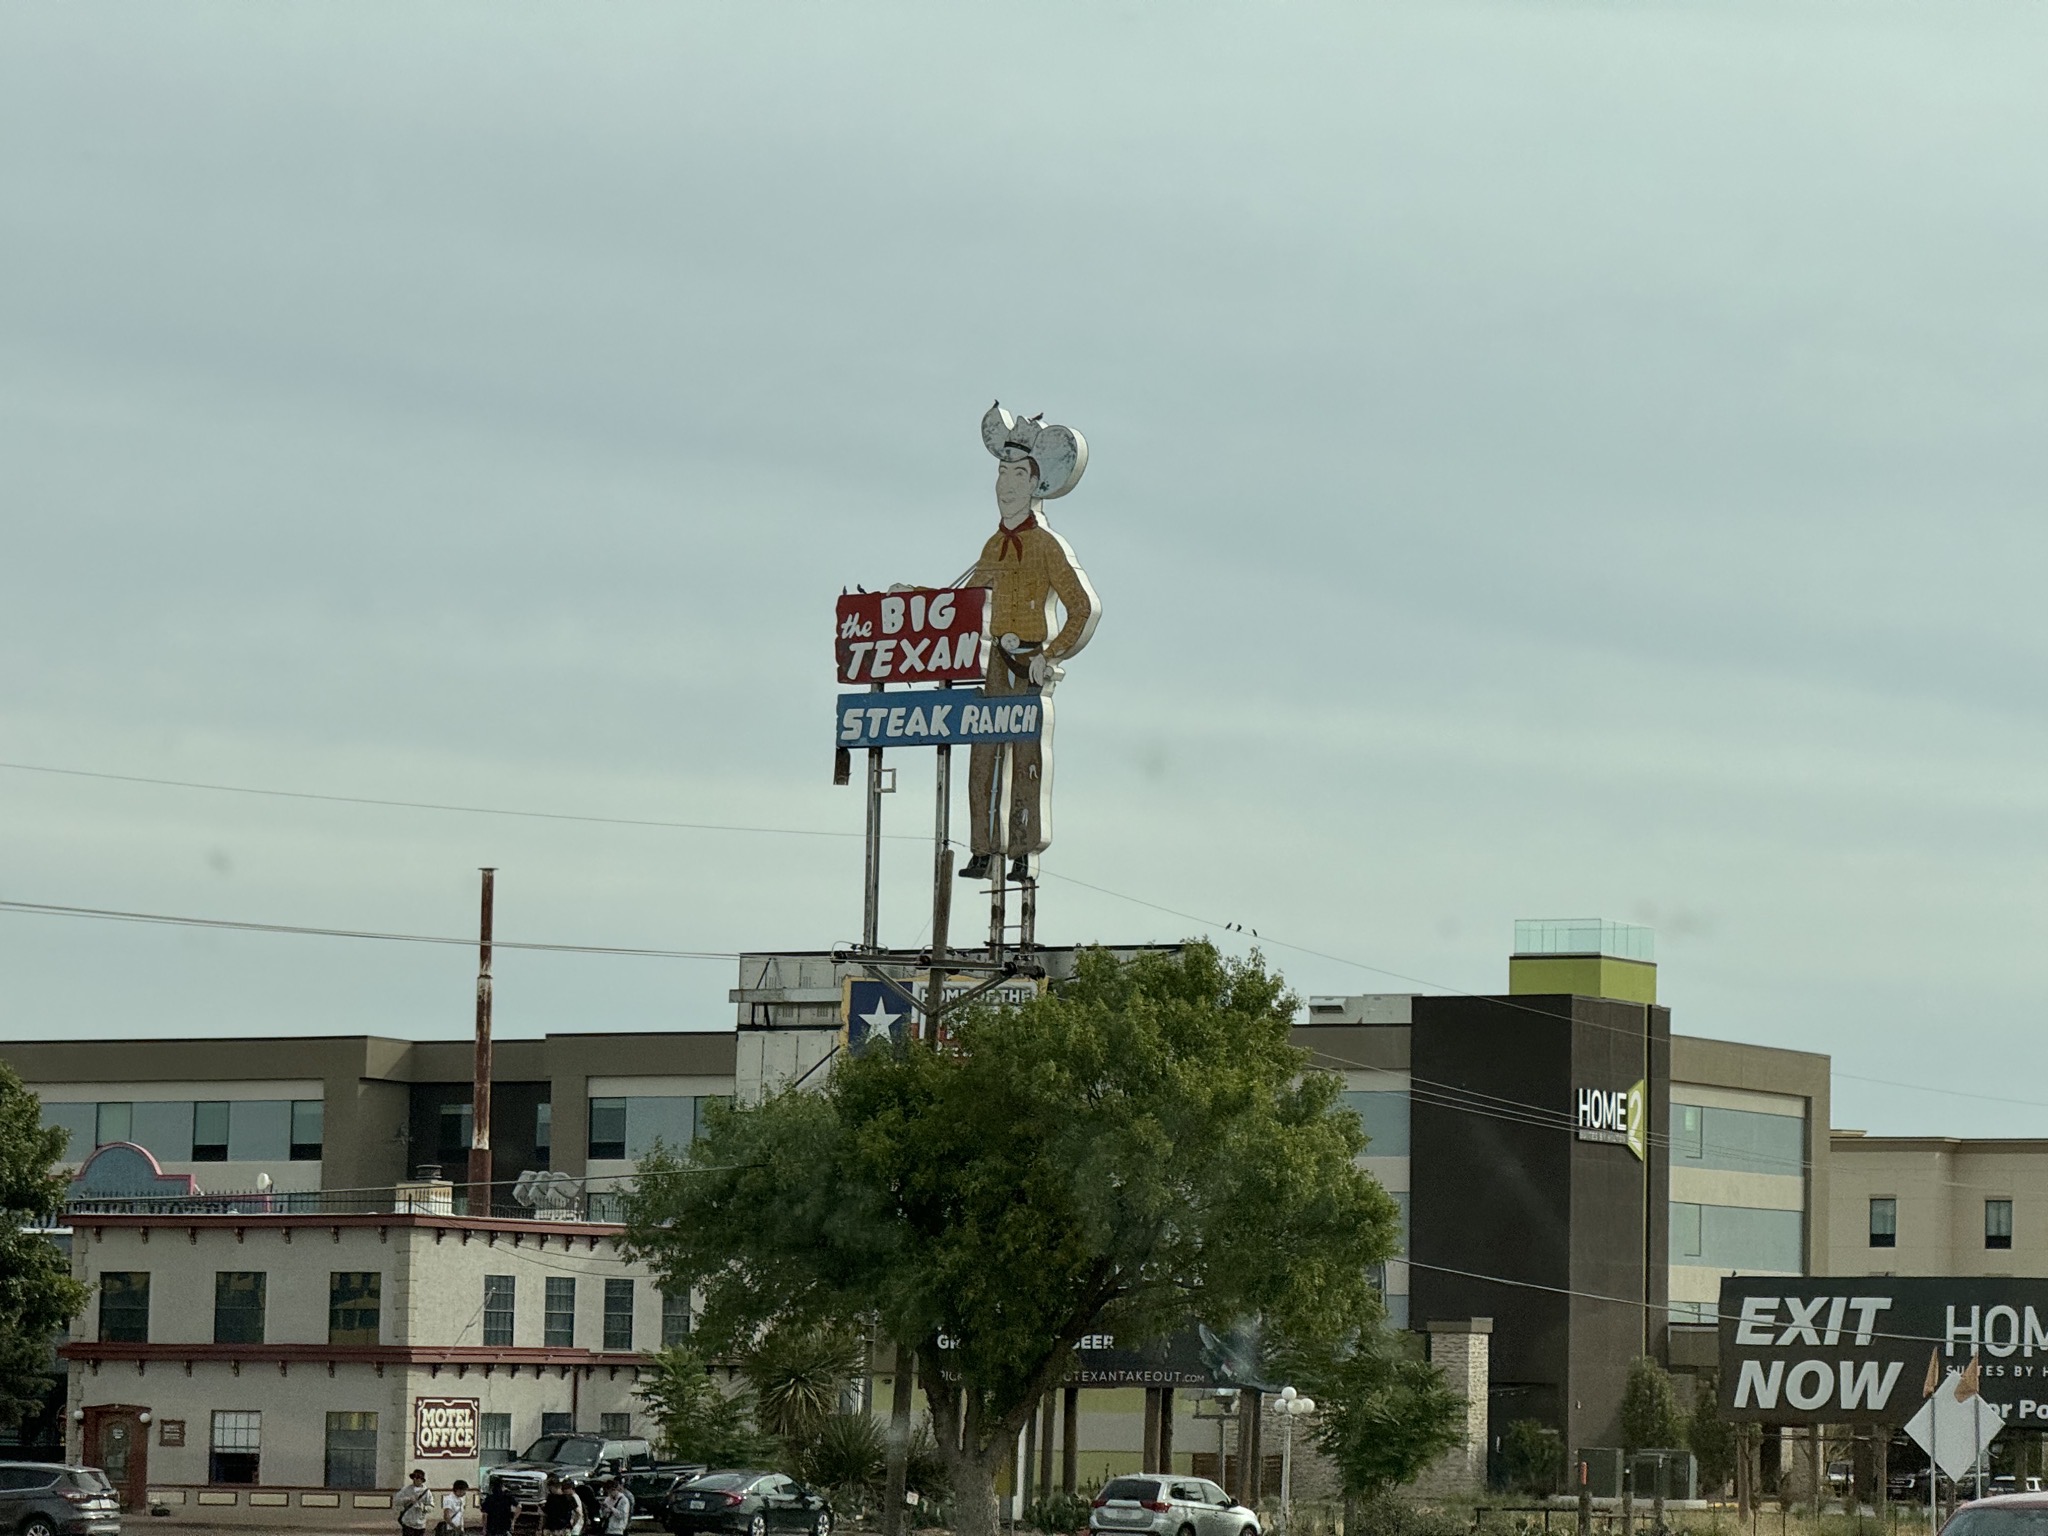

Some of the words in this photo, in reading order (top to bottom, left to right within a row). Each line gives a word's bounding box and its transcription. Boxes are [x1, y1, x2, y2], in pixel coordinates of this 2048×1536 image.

[841, 612, 872, 639] the
[881, 592, 956, 634] BIG
[847, 631, 980, 680] TEXAN
[840, 705, 953, 741] STEAK
[959, 705, 1038, 735] RANCH
[1735, 1297, 1893, 1346] EXIT
[1945, 1305, 2048, 1358] HOM
[1072, 1334, 1114, 1350] EER
[1733, 1359, 1904, 1411] NOW
[1946, 1365, 2005, 1377] SUTES
[2014, 1366, 2034, 1377] BY
[421, 1408, 474, 1428] MOTEL
[2019, 1400, 2048, 1420] Po
[420, 1427, 474, 1448] OFFICE
